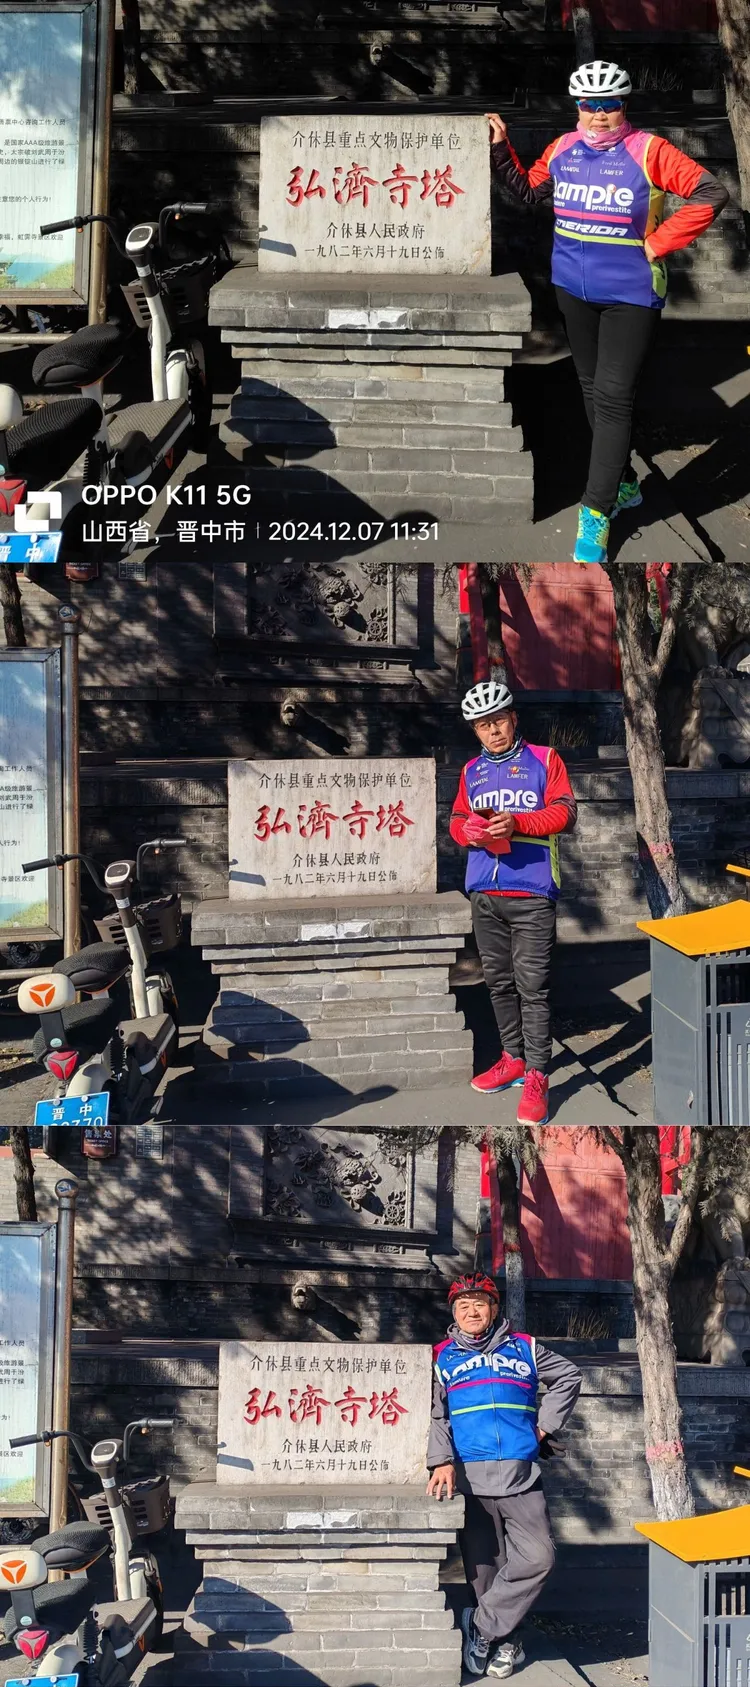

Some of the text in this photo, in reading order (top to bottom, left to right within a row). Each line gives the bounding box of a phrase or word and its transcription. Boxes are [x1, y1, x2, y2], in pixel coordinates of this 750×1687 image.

[292, 130, 461, 150] 介休县重点文物保护单位
[286, 162, 466, 209] 弘濟寺塔
[326, 222, 425, 239] 介休县人民政府
[259, 772, 413, 789] 介休县重点文物保护单位
[254, 800, 415, 843] 弘濟寺塔
[293, 851, 380, 868] 介休县人民政府
[250, 1355, 407, 1375] 介休县重点文物保护单位
[243, 1384, 409, 1428] 弘濟寺塔
[282, 1438, 373, 1454] 介休县人民政府
